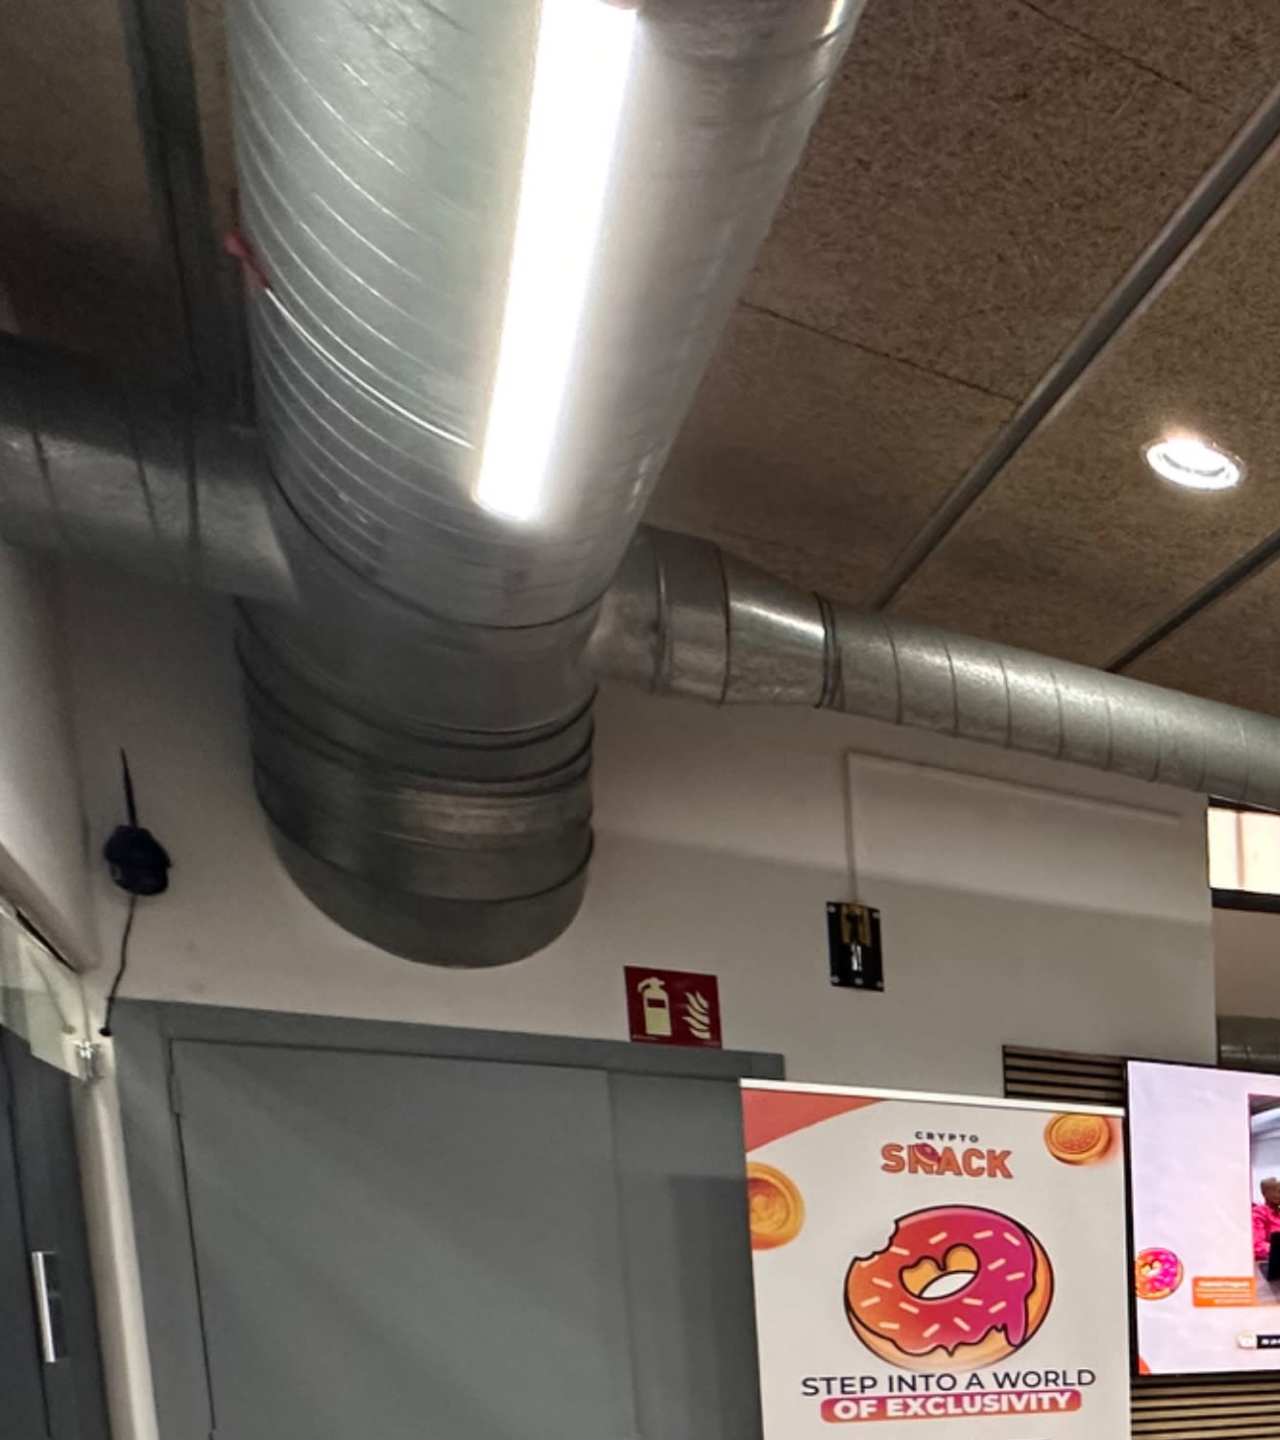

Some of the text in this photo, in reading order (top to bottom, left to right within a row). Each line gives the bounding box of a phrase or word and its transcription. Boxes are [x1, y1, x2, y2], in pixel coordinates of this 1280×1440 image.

[915, 1131, 979, 1143] CRYPTO
[881, 1143, 1013, 1179] SNACK
[801, 1369, 1096, 1396] STEP INTO A WORLD
[833, 1392, 1071, 1419] OF EXCLUSIVITY
